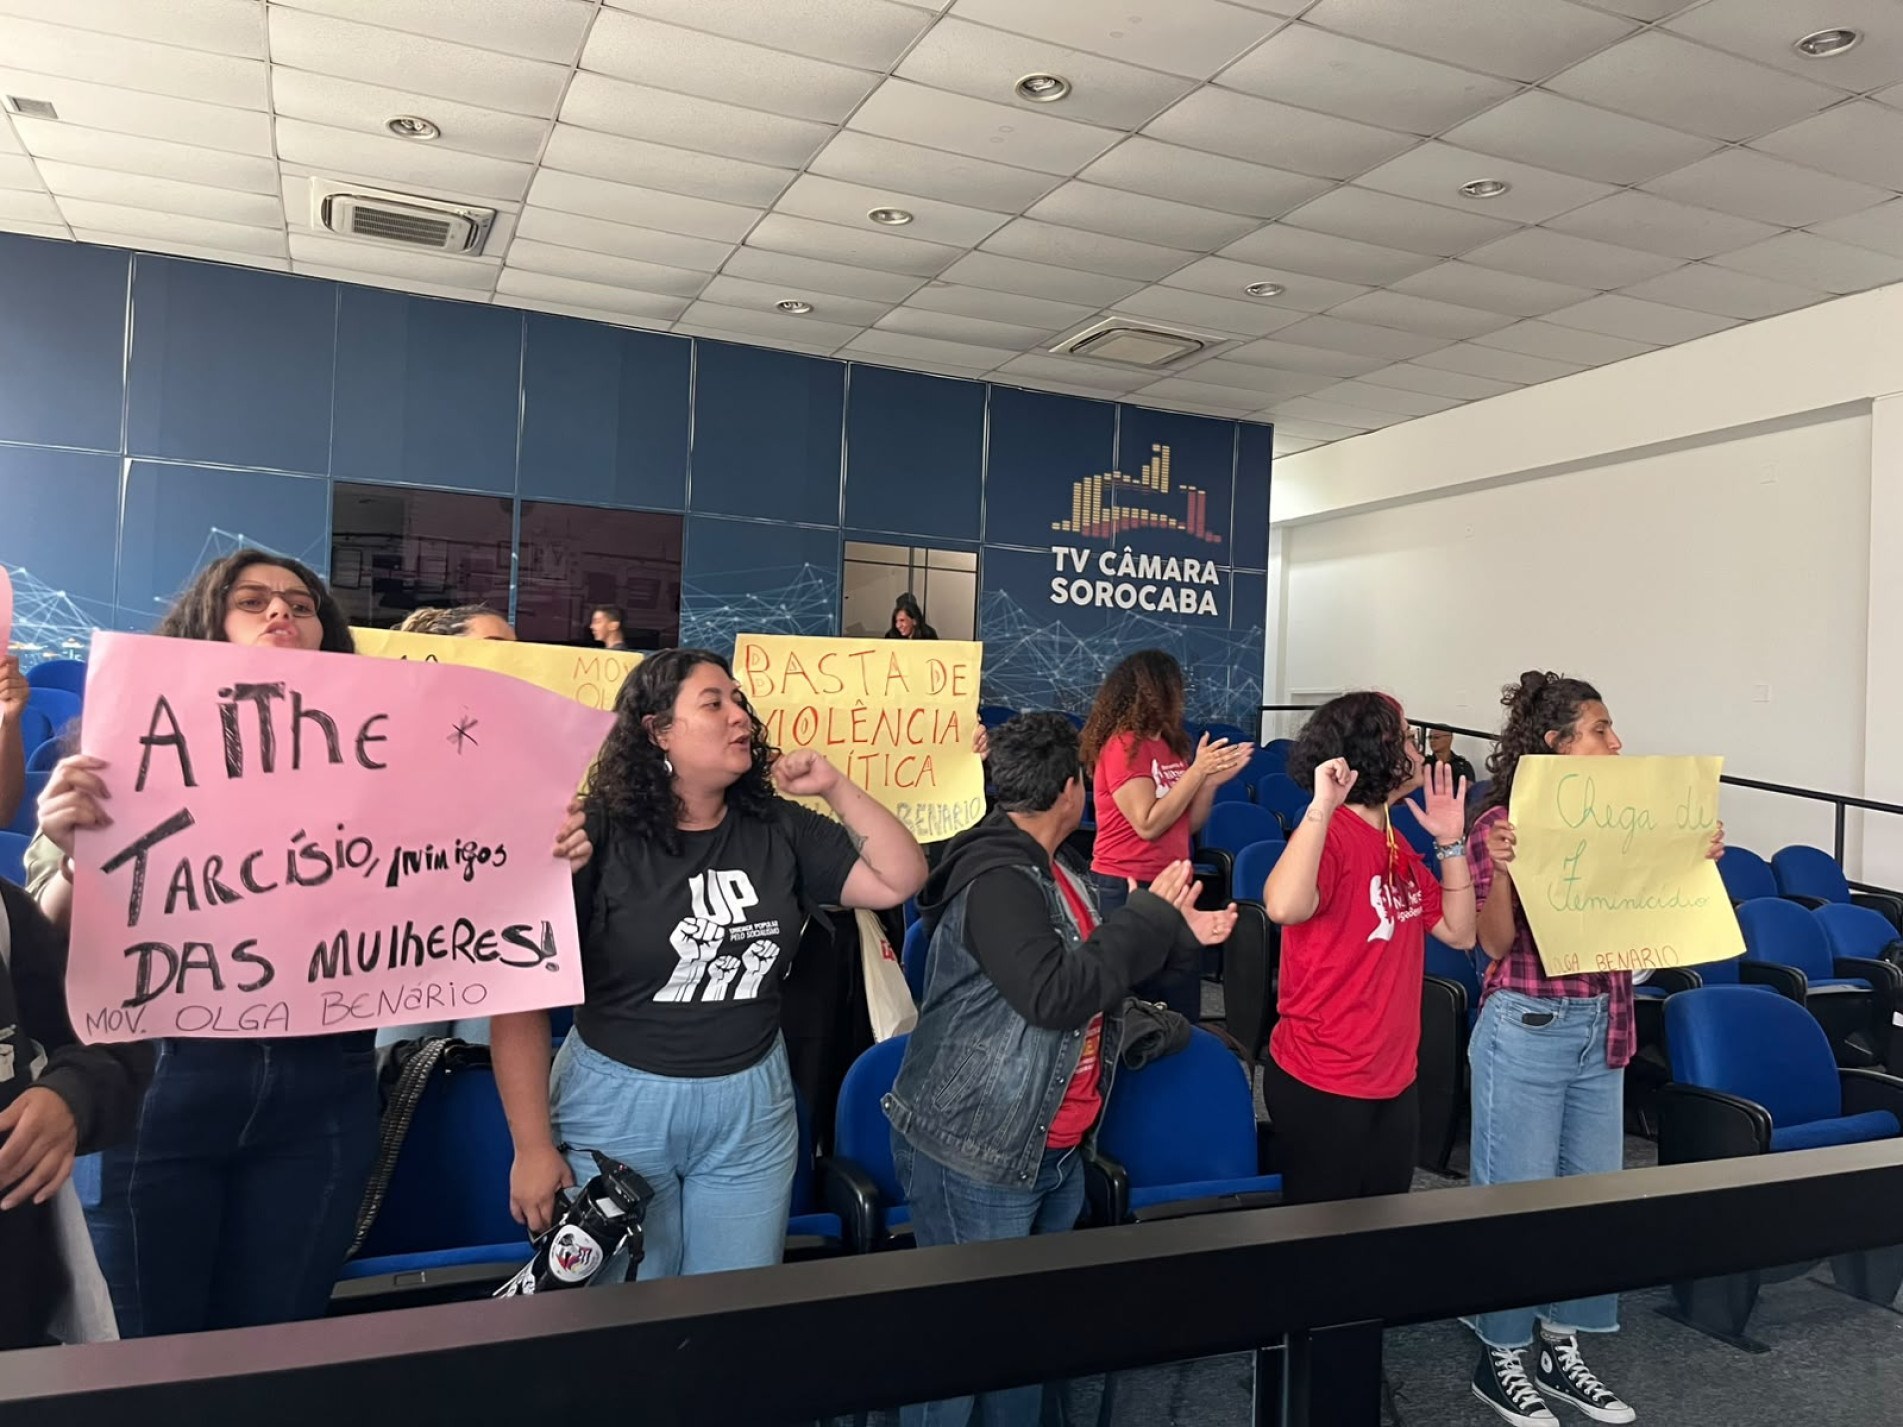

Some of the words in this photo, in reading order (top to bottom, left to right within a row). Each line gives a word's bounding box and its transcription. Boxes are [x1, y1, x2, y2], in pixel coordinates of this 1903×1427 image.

[1051, 546, 1091, 573] TV
[1098, 545, 1220, 585] CÂMARA
[1050, 577, 1218, 616] SOROCABA
[573, 656, 629, 683] MO
[746, 644, 910, 698] BASTA
[925, 658, 968, 697] DE
[823, 750, 937, 790] ÍTICA
[1557, 774, 1657, 854] Chega
[1676, 785, 1714, 830] de
[688, 869, 760, 926] UP
[122, 937, 276, 1008] DAS
[1595, 945, 1679, 972] BENARIO
[86, 1005, 147, 1037] MOV.
[175, 1001, 290, 1032] OLGA
